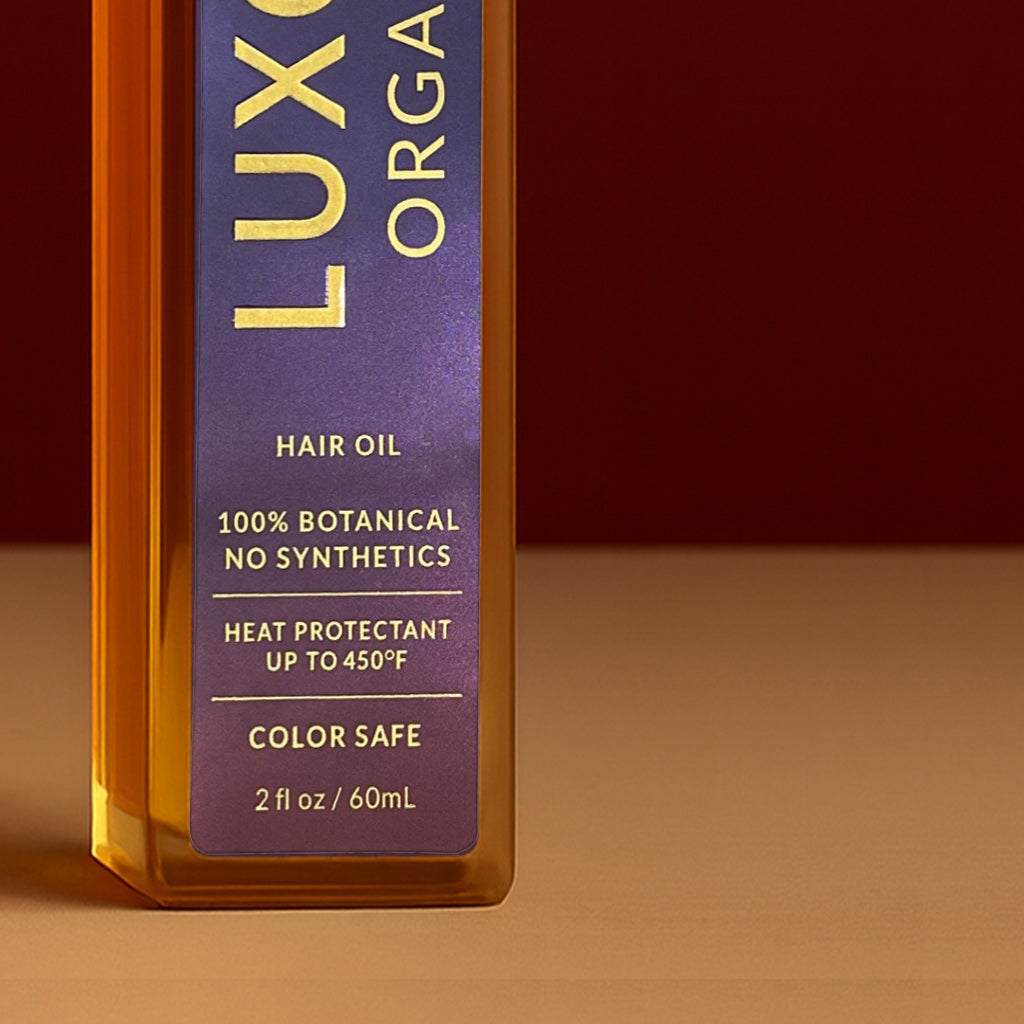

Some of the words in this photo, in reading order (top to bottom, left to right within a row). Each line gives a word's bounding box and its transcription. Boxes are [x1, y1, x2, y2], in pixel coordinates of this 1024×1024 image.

[276, 435, 345, 457] HAIR
[355, 434, 401, 456] OIL
[218, 510, 288, 533] 100%
[299, 509, 460, 532] BOTANICAL
[225, 547, 266, 570] NO
[276, 545, 451, 569] SYNTHETICS
[225, 622, 286, 642] HEAT
[295, 619, 452, 641] PROTECTANT
[266, 651, 297, 671] UP
[306, 651, 337, 671] TO
[343, 649, 407, 670] 450°F
[249, 726, 345, 749] COLOR
[355, 724, 421, 747] SAFE
[255, 788, 269, 811] 2
[276, 787, 290, 810] fl
[298, 792, 325, 810] oz
[331, 787, 342, 811] /
[349, 786, 416, 809] 60mL
